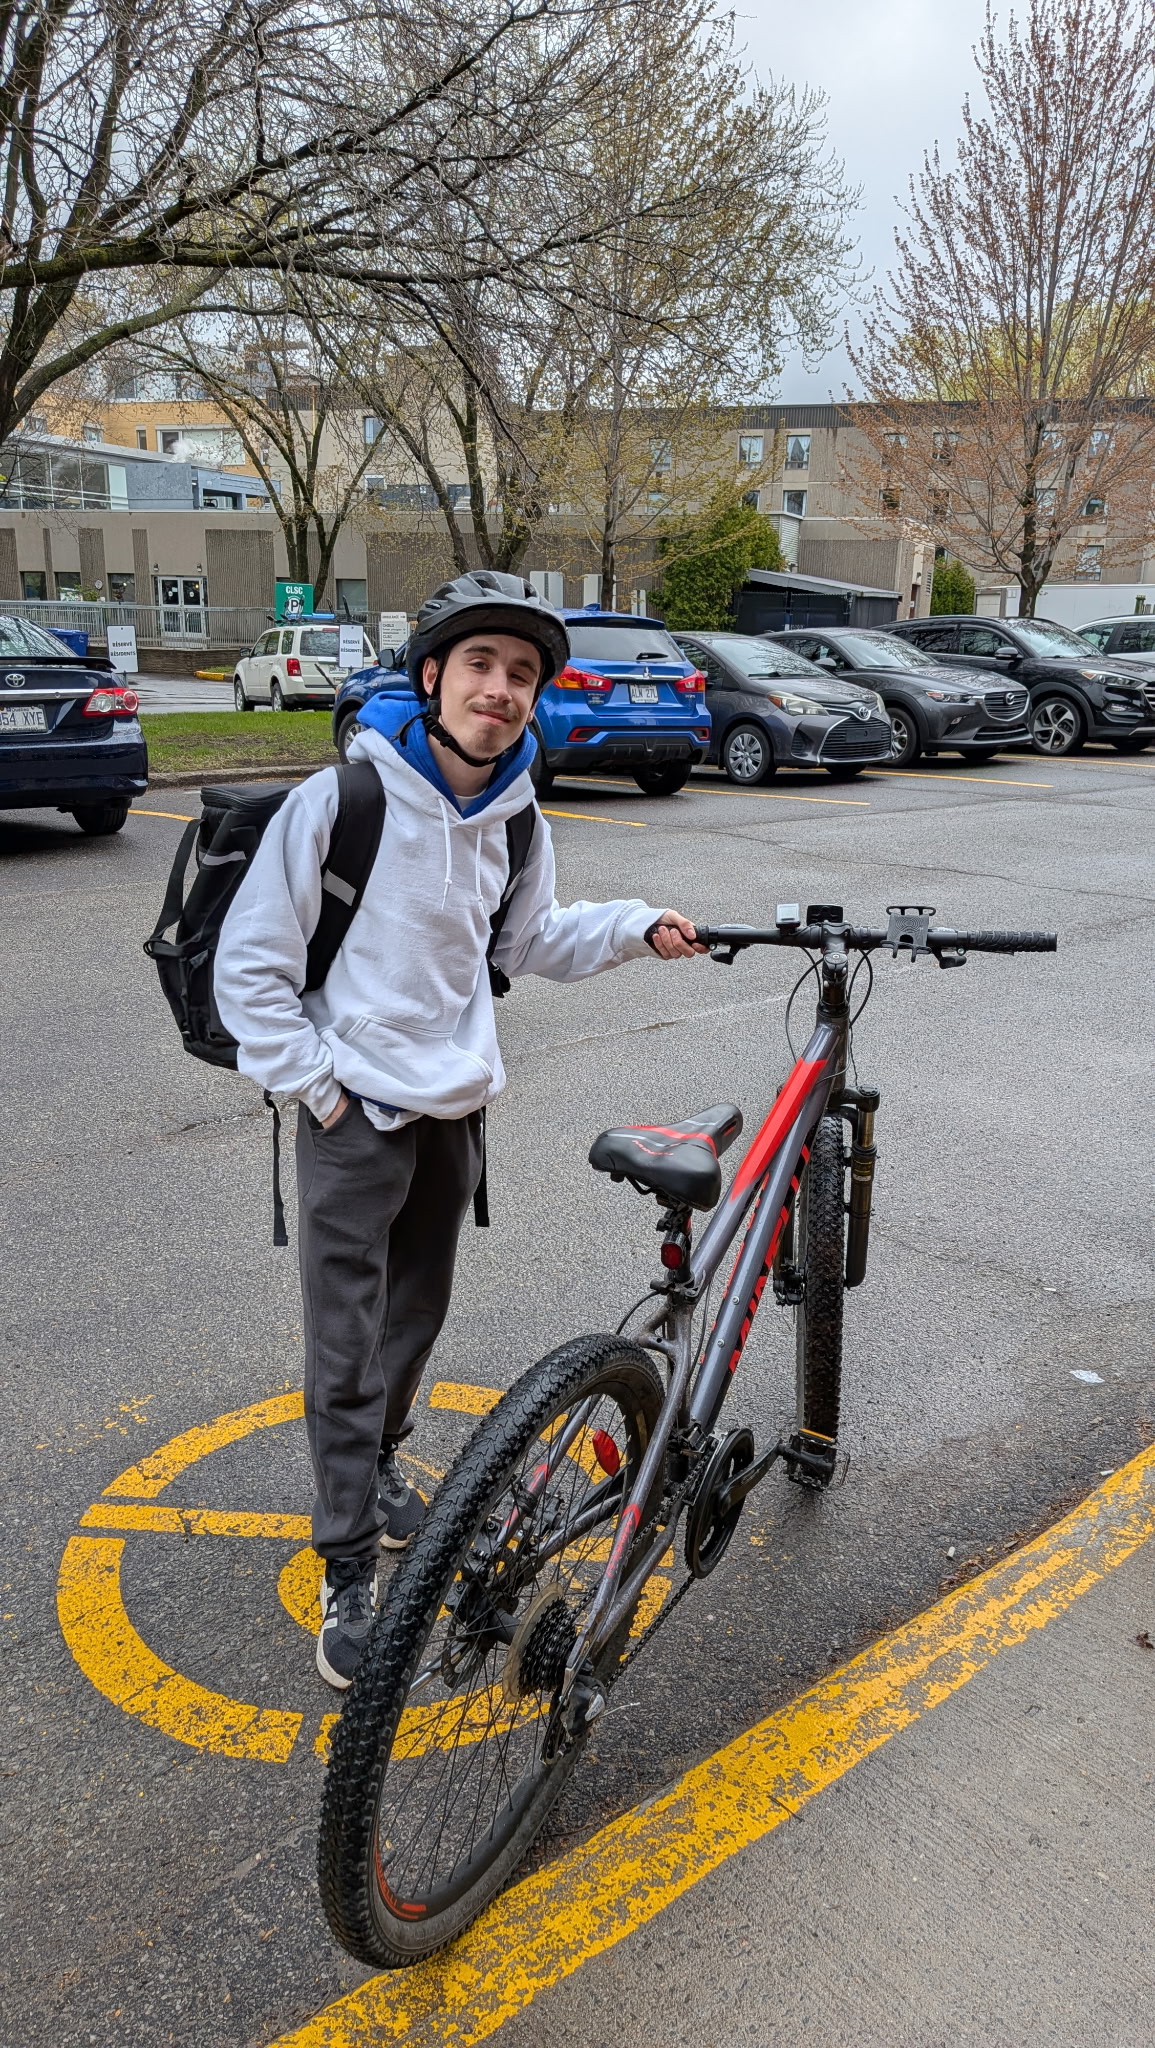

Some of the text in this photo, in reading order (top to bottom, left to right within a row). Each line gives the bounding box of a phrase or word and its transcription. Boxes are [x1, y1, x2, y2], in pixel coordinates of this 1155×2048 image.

[285, 585, 303, 595] CLSC
[290, 599, 299, 612] P
[22, 711, 45, 726] XYE
